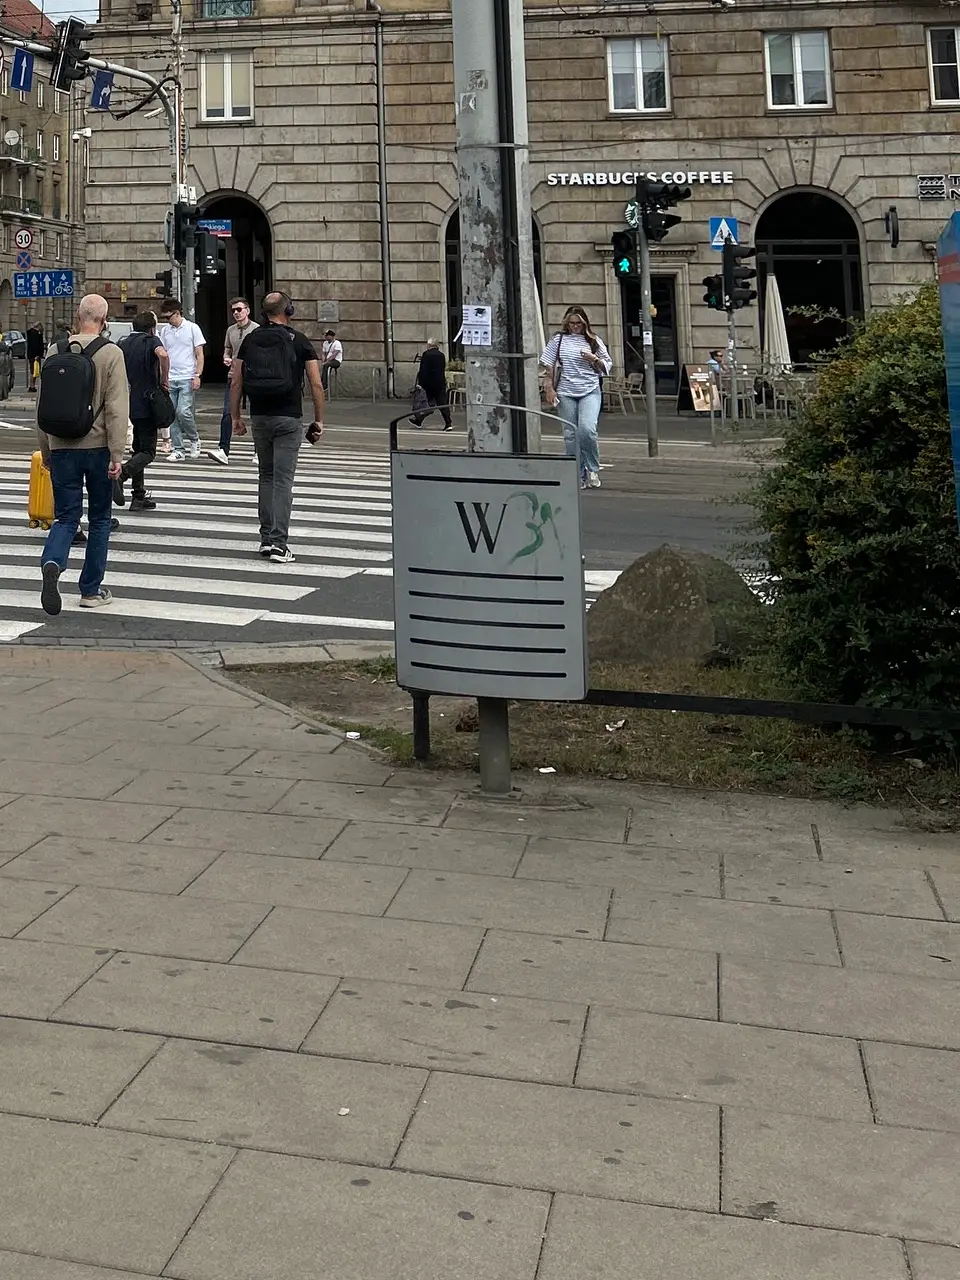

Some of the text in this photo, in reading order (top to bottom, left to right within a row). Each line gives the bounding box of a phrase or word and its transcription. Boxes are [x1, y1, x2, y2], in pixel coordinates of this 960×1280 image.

[661, 171, 734, 185] COFFEE
[17, 234, 30, 244] 30
[454, 501, 508, 554] W
